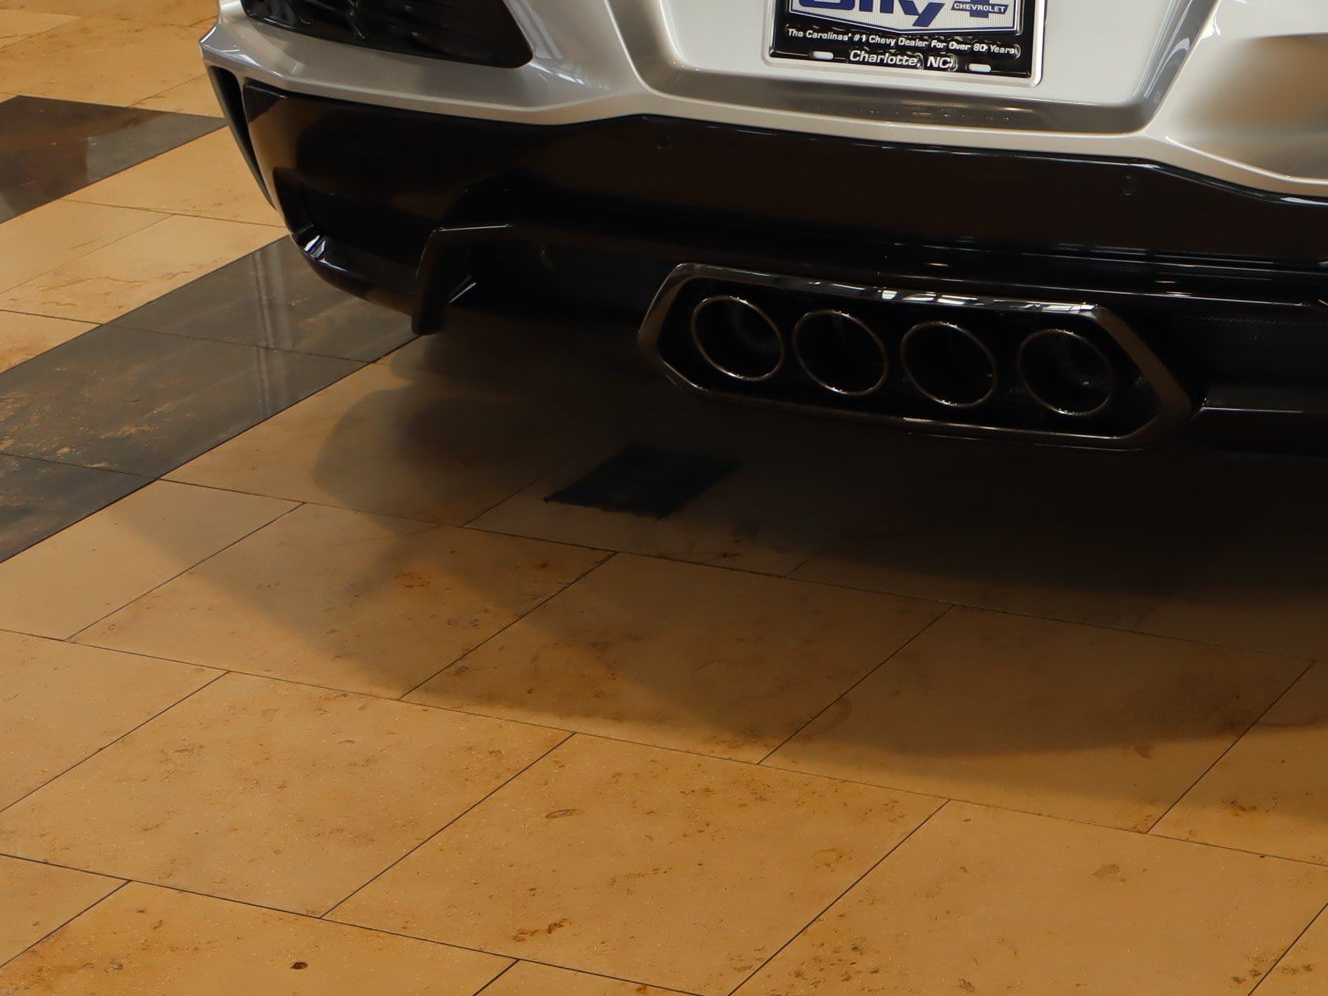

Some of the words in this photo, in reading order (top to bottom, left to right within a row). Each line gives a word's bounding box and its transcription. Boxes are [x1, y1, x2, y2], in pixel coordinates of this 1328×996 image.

[954, 2, 1006, 14] CHEVROLET
[788, 28, 803, 38] The
[853, 34, 866, 43] #1
[869, 35, 896, 46] Chevy
[898, 37, 928, 48] Dealer
[931, 40, 946, 49] For
[949, 41, 971, 51] Over
[850, 49, 921, 68] Charlotte,
[927, 56, 952, 69] NC
